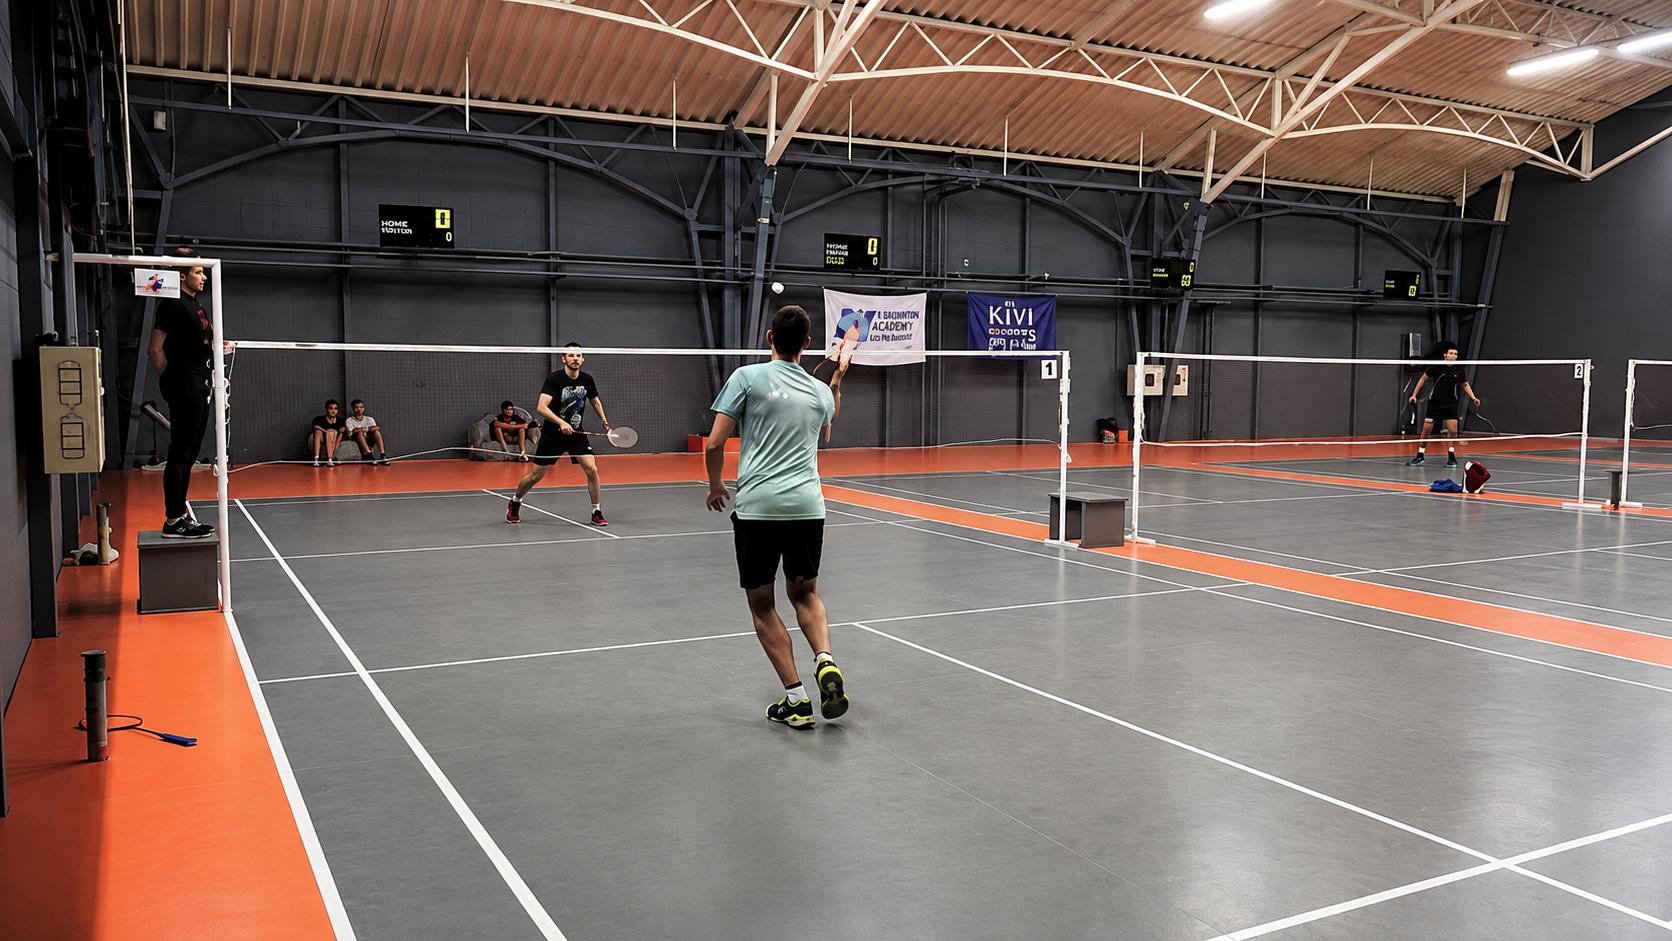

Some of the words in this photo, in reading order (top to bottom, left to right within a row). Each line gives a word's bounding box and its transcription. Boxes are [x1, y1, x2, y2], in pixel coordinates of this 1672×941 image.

[381, 220, 408, 228] HOME
[445, 231, 453, 242] 0
[872, 256, 878, 266] 0
[872, 320, 913, 332] ACADEMY
[1045, 361, 1053, 376] 1
[1576, 365, 1582, 376] 2
